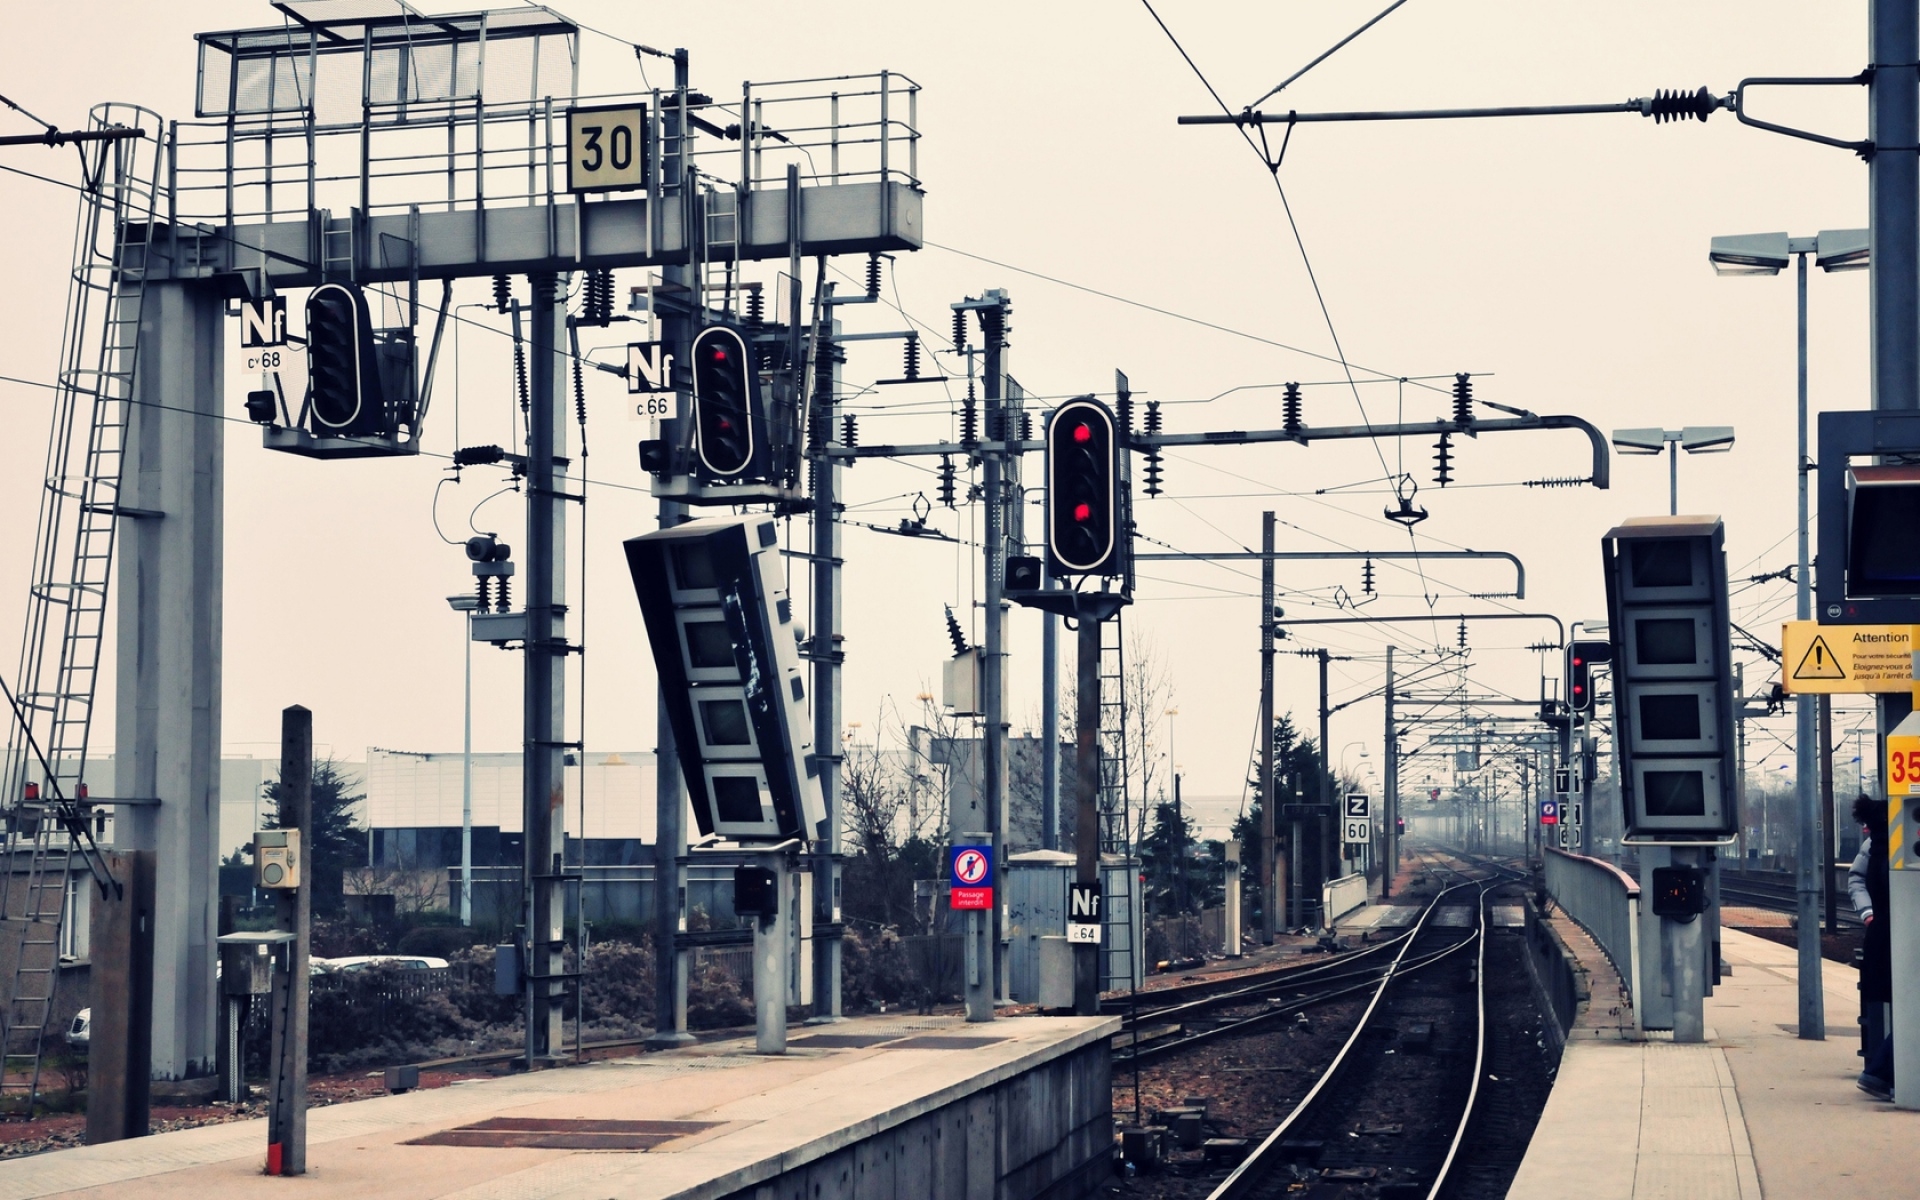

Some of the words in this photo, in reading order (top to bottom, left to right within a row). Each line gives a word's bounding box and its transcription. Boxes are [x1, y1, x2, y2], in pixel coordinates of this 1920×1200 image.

[581, 125, 632, 172] 30
[242, 300, 285, 345] Nf
[629, 345, 674, 391] Nf
[1852, 632, 1910, 643] Attention
[1892, 751, 1920, 783] 35
[1351, 798, 1365, 813] Z
[1348, 823, 1367, 839] 60
[958, 891, 985, 900] Passage
[1072, 888, 1100, 916] Nf
